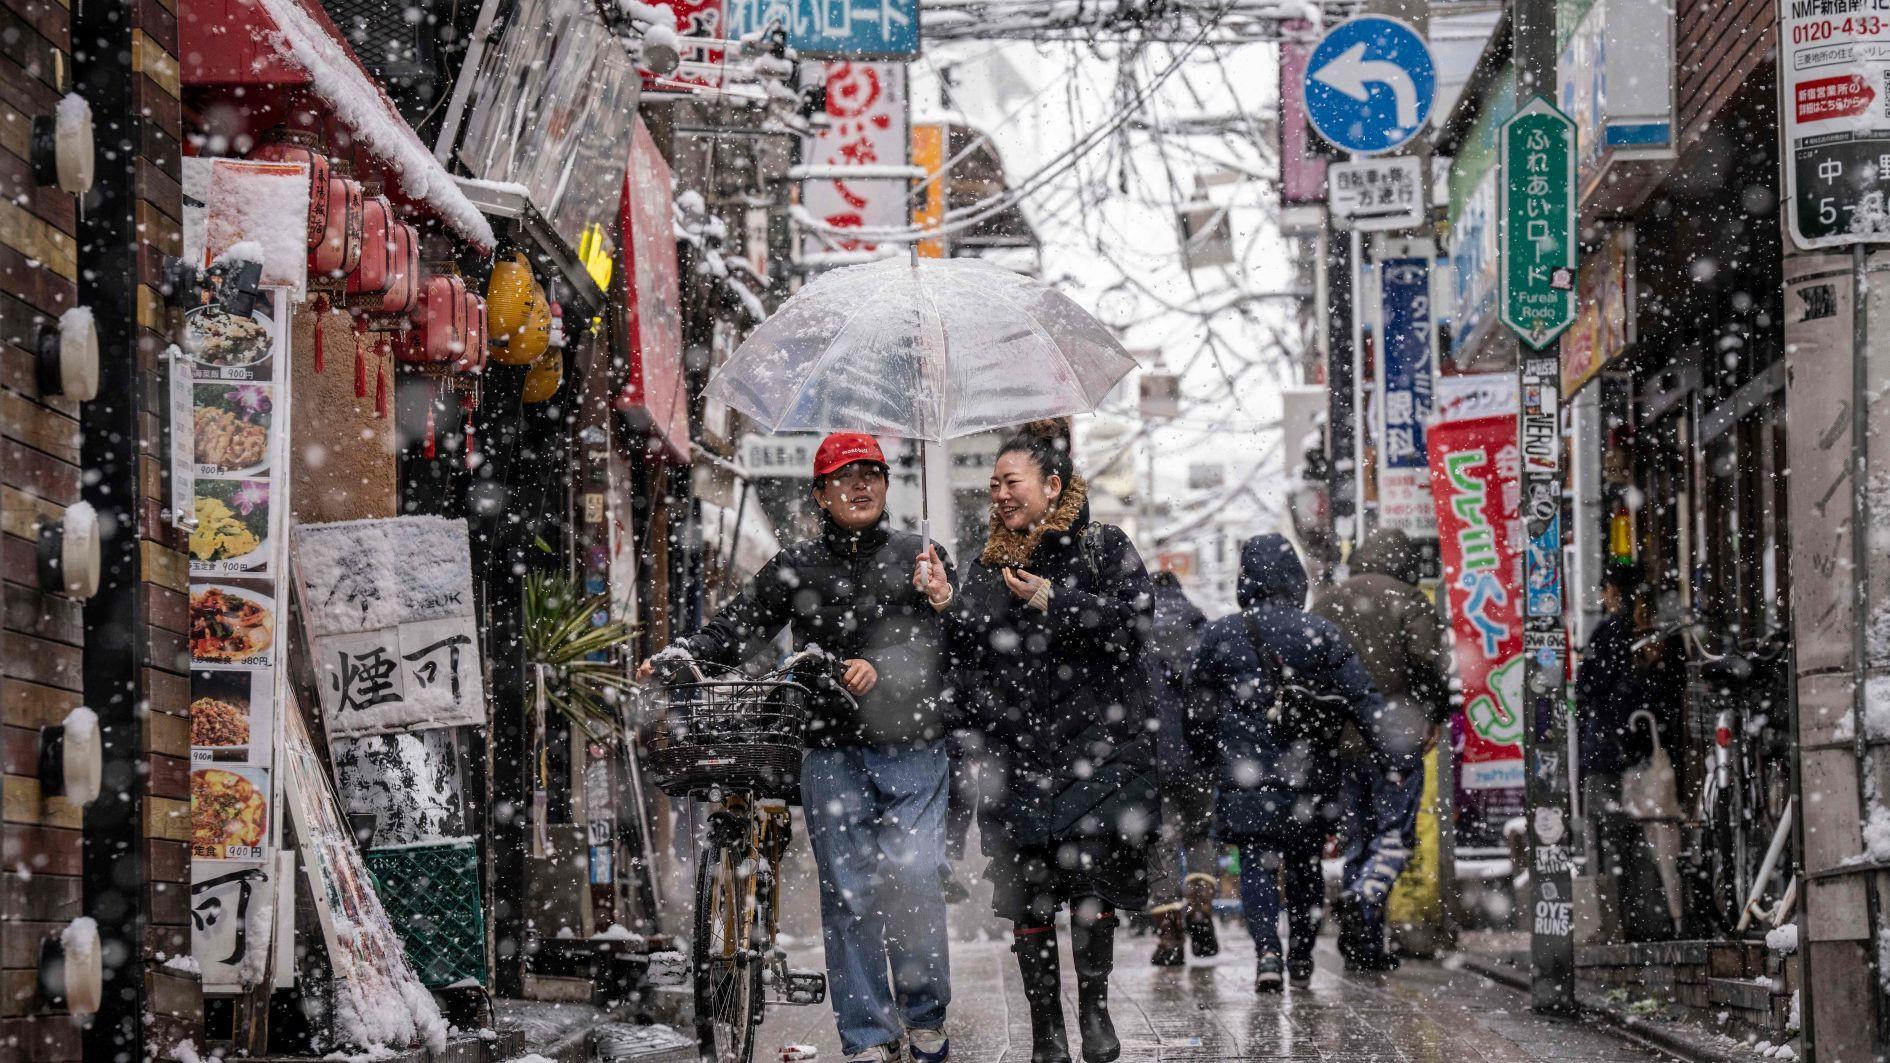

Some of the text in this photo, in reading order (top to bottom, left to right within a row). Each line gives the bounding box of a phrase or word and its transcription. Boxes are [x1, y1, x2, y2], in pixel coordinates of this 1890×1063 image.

[1793, 16, 1888, 44] 0120-433-
[1526, 128, 1550, 287] ふれあいロード
[1518, 290, 1558, 304] Fureai
[1522, 305, 1556, 319] Rodo
[228, 368, 254, 379] 900円
[1526, 412, 1554, 456] NERO
[229, 846, 262, 857] 900円
[1536, 901, 1571, 920] OYE
[1534, 918, 1569, 936] RUNS
